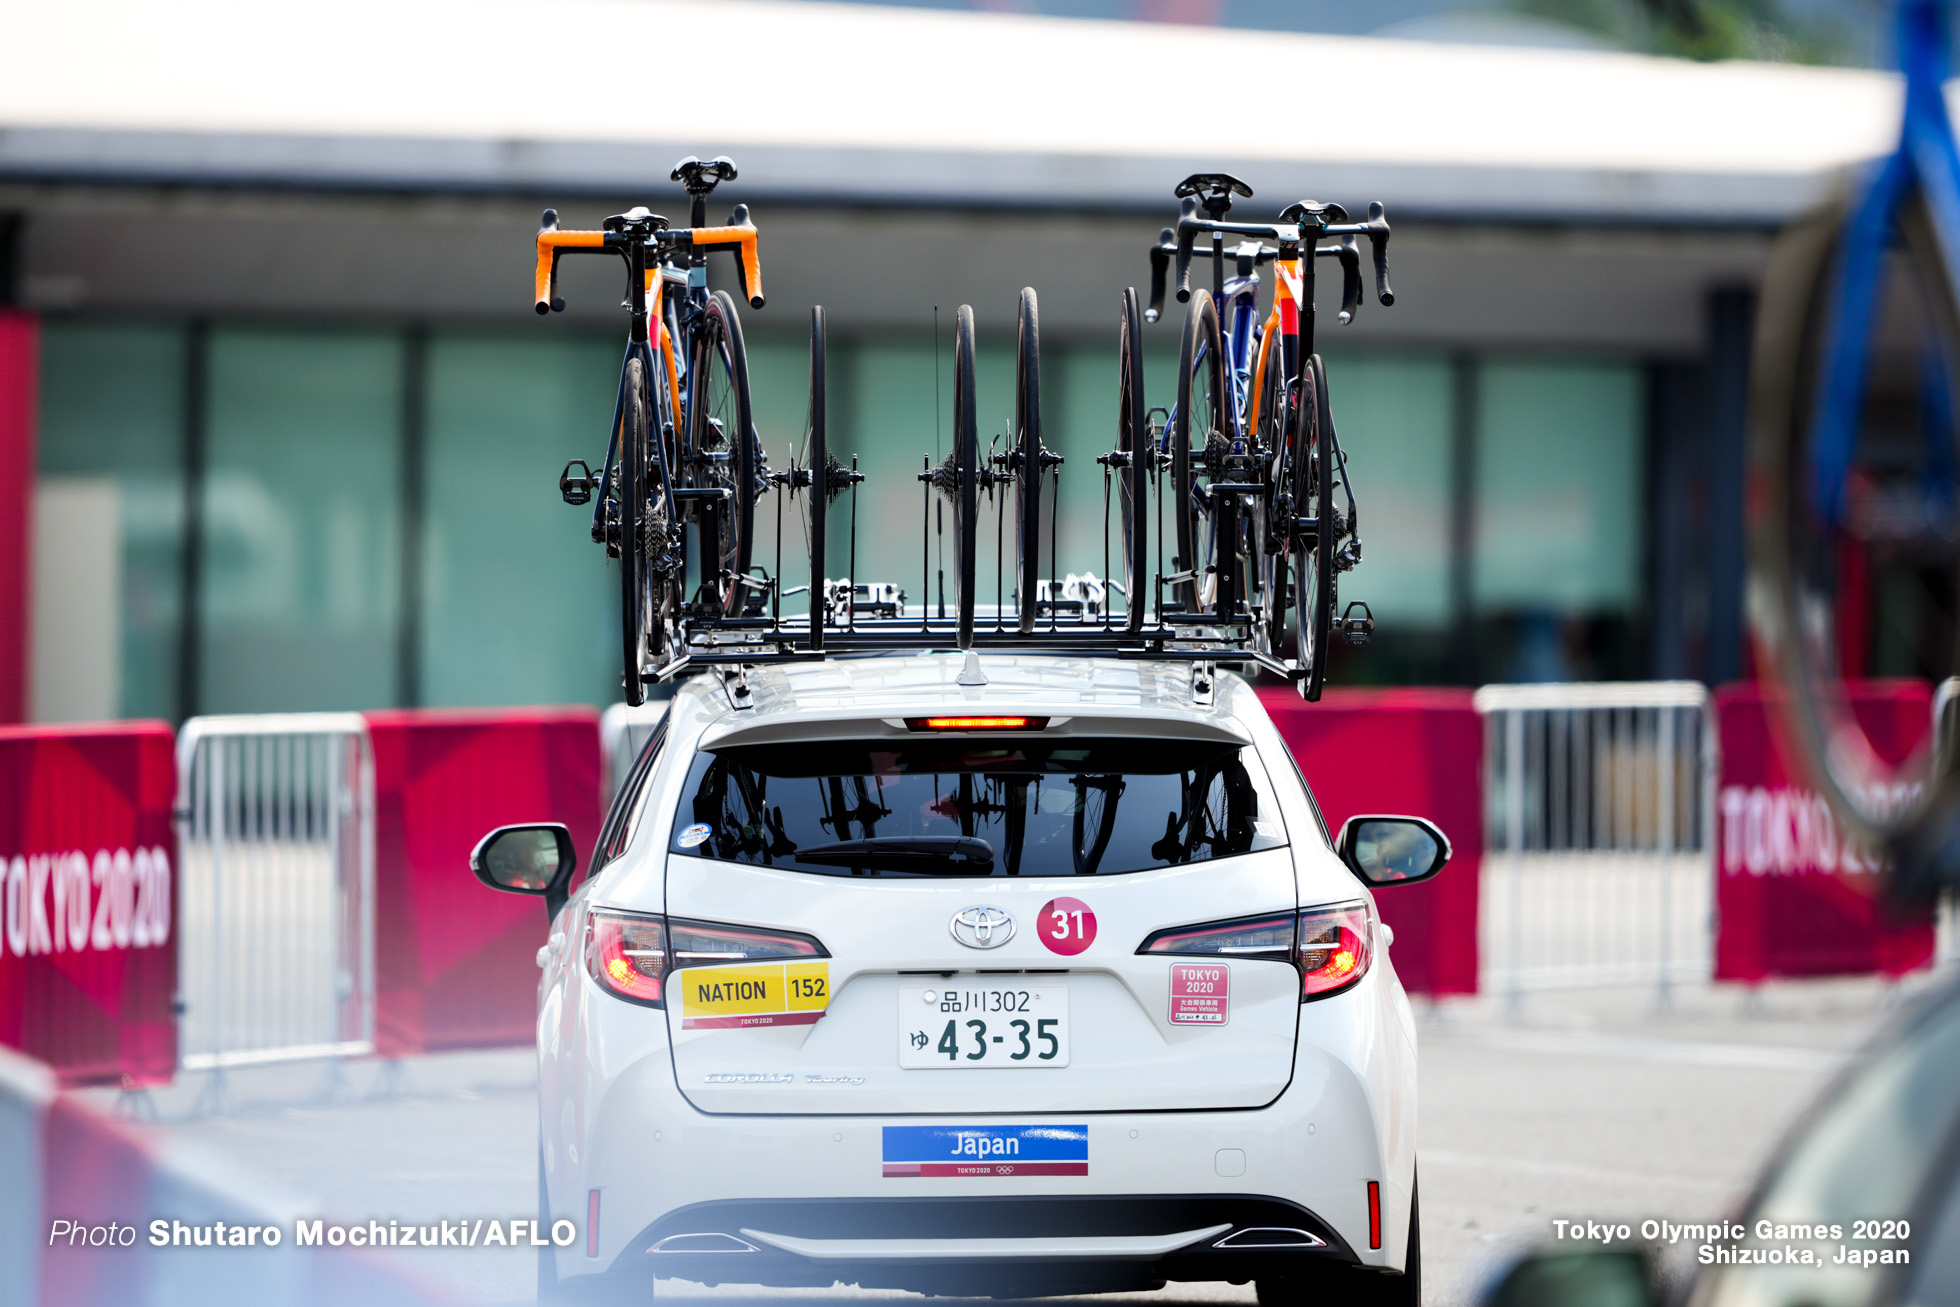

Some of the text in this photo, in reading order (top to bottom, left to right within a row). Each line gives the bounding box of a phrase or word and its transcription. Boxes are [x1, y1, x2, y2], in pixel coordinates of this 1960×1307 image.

[1722, 785, 1837, 876] TOKYO
[91, 844, 171, 950] 2020
[1051, 909, 1084, 939] 31
[1181, 969, 1219, 981] TOKYO
[1186, 982, 1214, 993] 2020
[698, 978, 826, 1003] NATION 152
[910, 1018, 1059, 1061] ゆ 43-35
[704, 1073, 866, 1085] COROLLA Touring
[950, 1132, 1019, 1159] Japan
